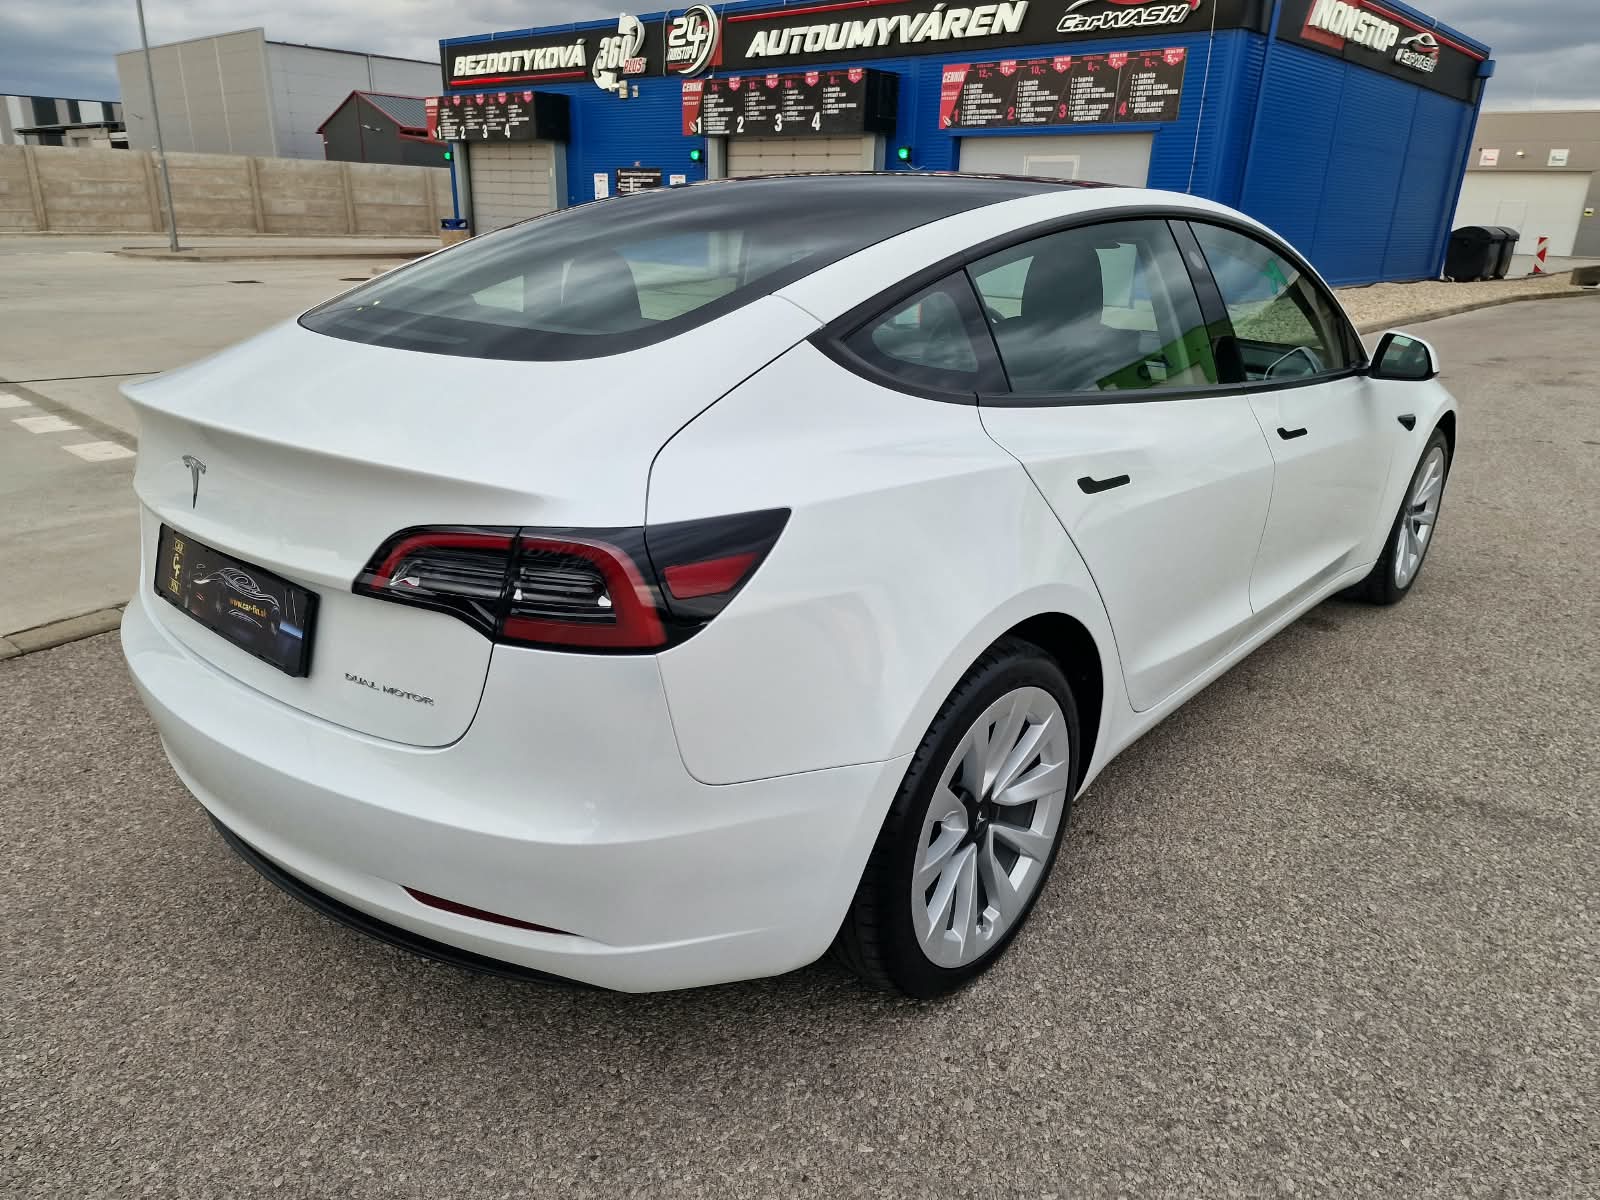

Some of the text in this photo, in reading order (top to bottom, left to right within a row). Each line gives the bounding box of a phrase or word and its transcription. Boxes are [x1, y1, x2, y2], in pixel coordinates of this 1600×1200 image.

[1056, 4, 1190, 32] CarWASH
[1308, 0, 1400, 52] NONSTOP
[669, 15, 707, 59] 24
[745, 0, 1029, 58] AUTOUMYVÁREN
[453, 38, 587, 77] BEZDOTYKOVÁ
[596, 35, 636, 70] 360
[623, 57, 647, 74] PLUS
[1007, 107, 1015, 120] 2
[1058, 103, 1067, 119] 3
[1119, 101, 1127, 116] 4
[695, 117, 702, 134] 1
[736, 116, 745, 133] 2
[774, 113, 783, 132] 3
[811, 112, 821, 131] 4
[437, 126, 442, 139] 1
[460, 125, 466, 139] 2
[482, 125, 488, 139] 3
[504, 123, 511, 138] 4
[344, 673, 435, 707] DUAL MOTOR
